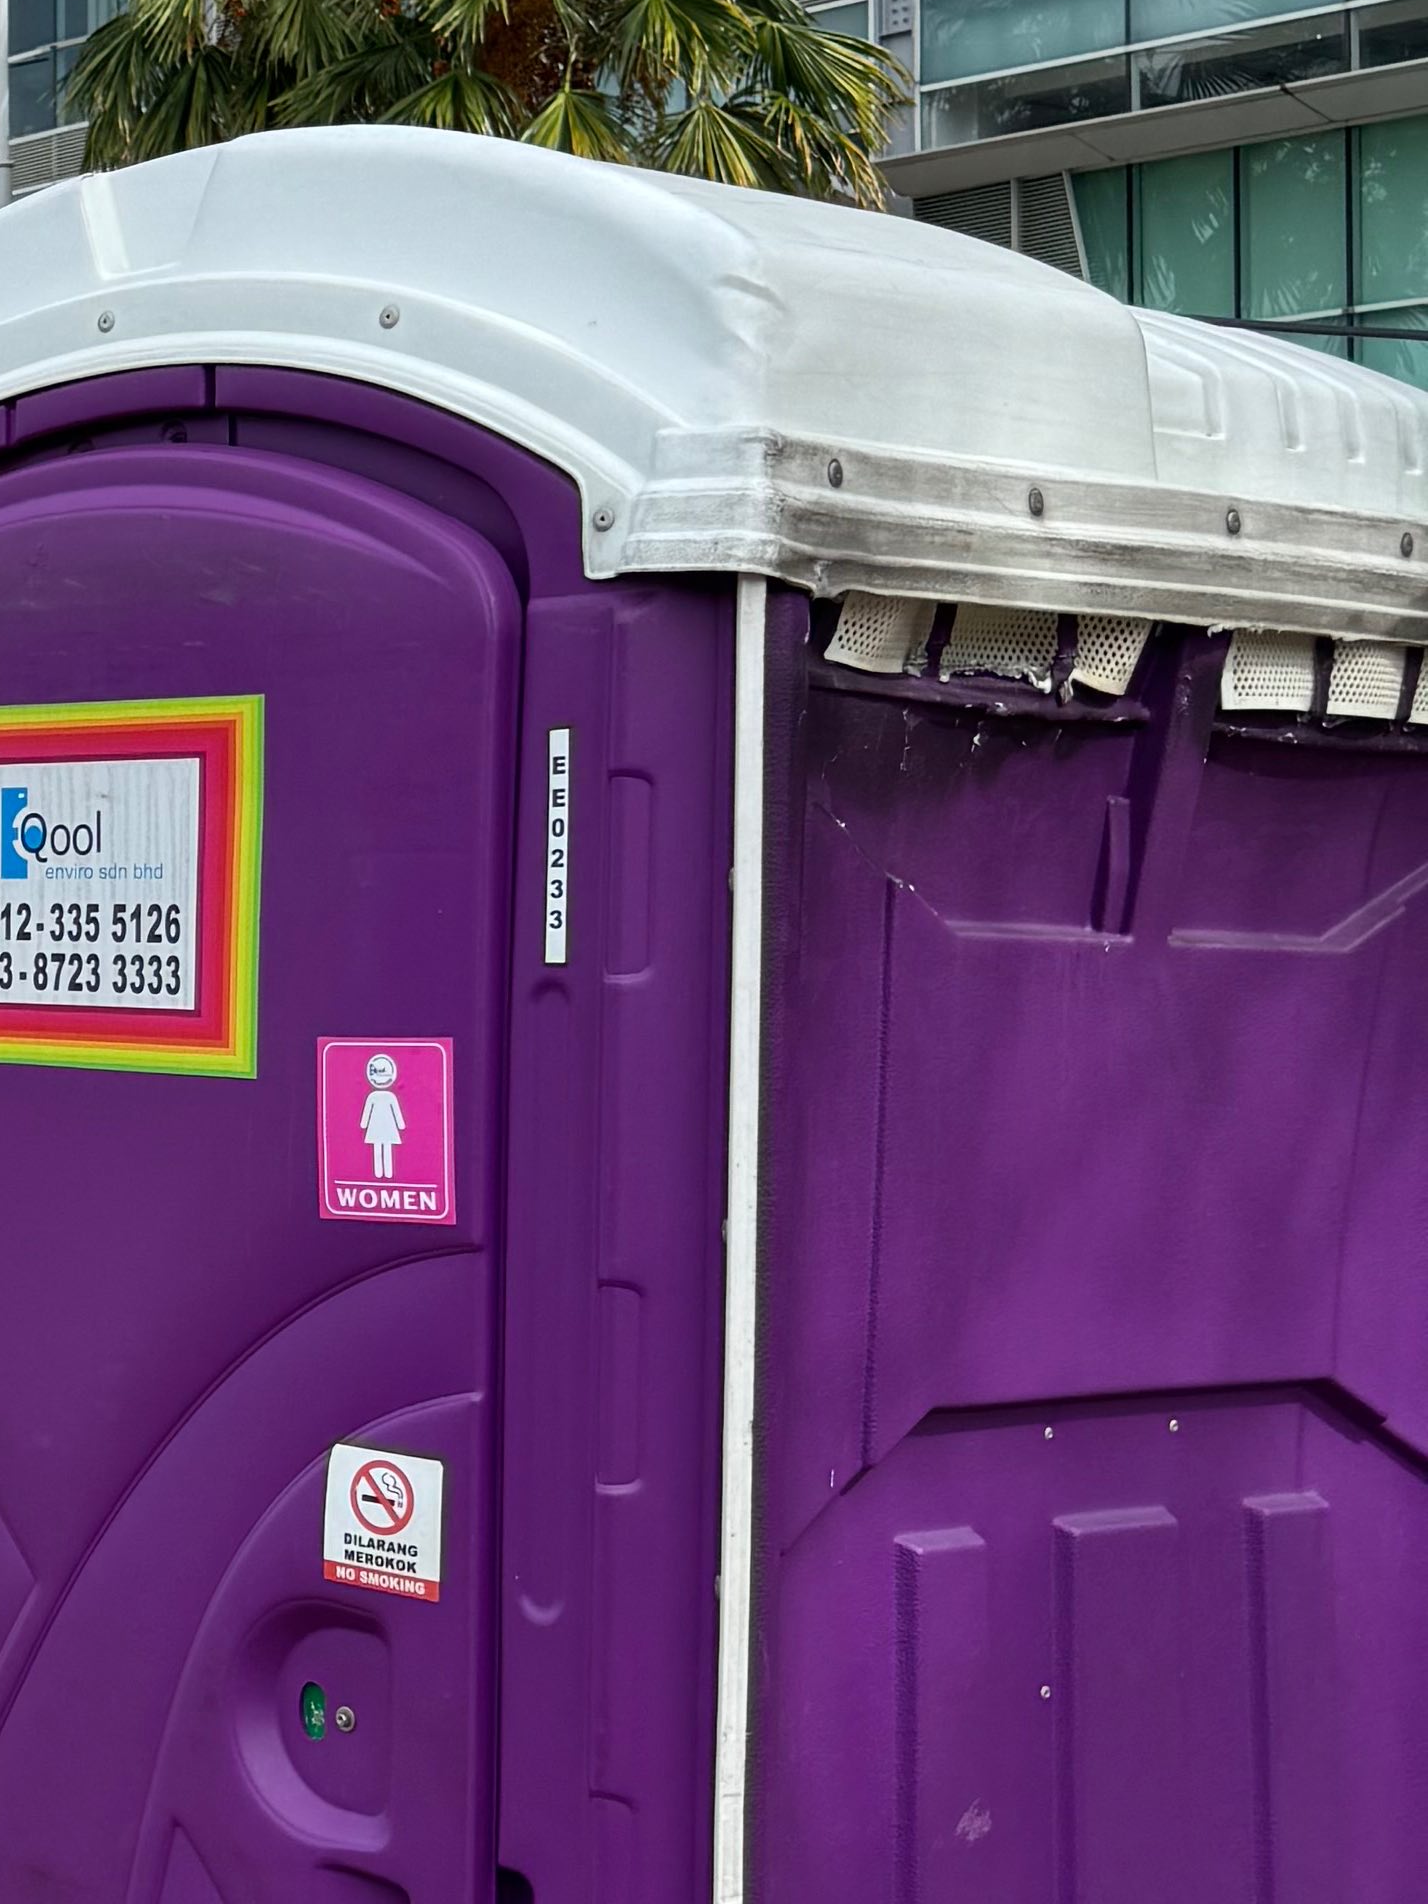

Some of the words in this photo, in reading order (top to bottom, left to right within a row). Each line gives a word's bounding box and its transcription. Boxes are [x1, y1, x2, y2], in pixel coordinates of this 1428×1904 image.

[549, 755, 567, 930] EE0233
[45, 865, 94, 880] enviro
[99, 863, 128, 880] sdn
[133, 862, 164, 880] bhd
[111, 902, 182, 945] 5126
[111, 953, 182, 996] 3333
[336, 1188, 438, 1211] WOMEN
[344, 1532, 419, 1558] DILARANG
[344, 1549, 418, 1574] MEROKOK
[335, 1565, 356, 1581] NO
[359, 1570, 426, 1595] SMOKING
